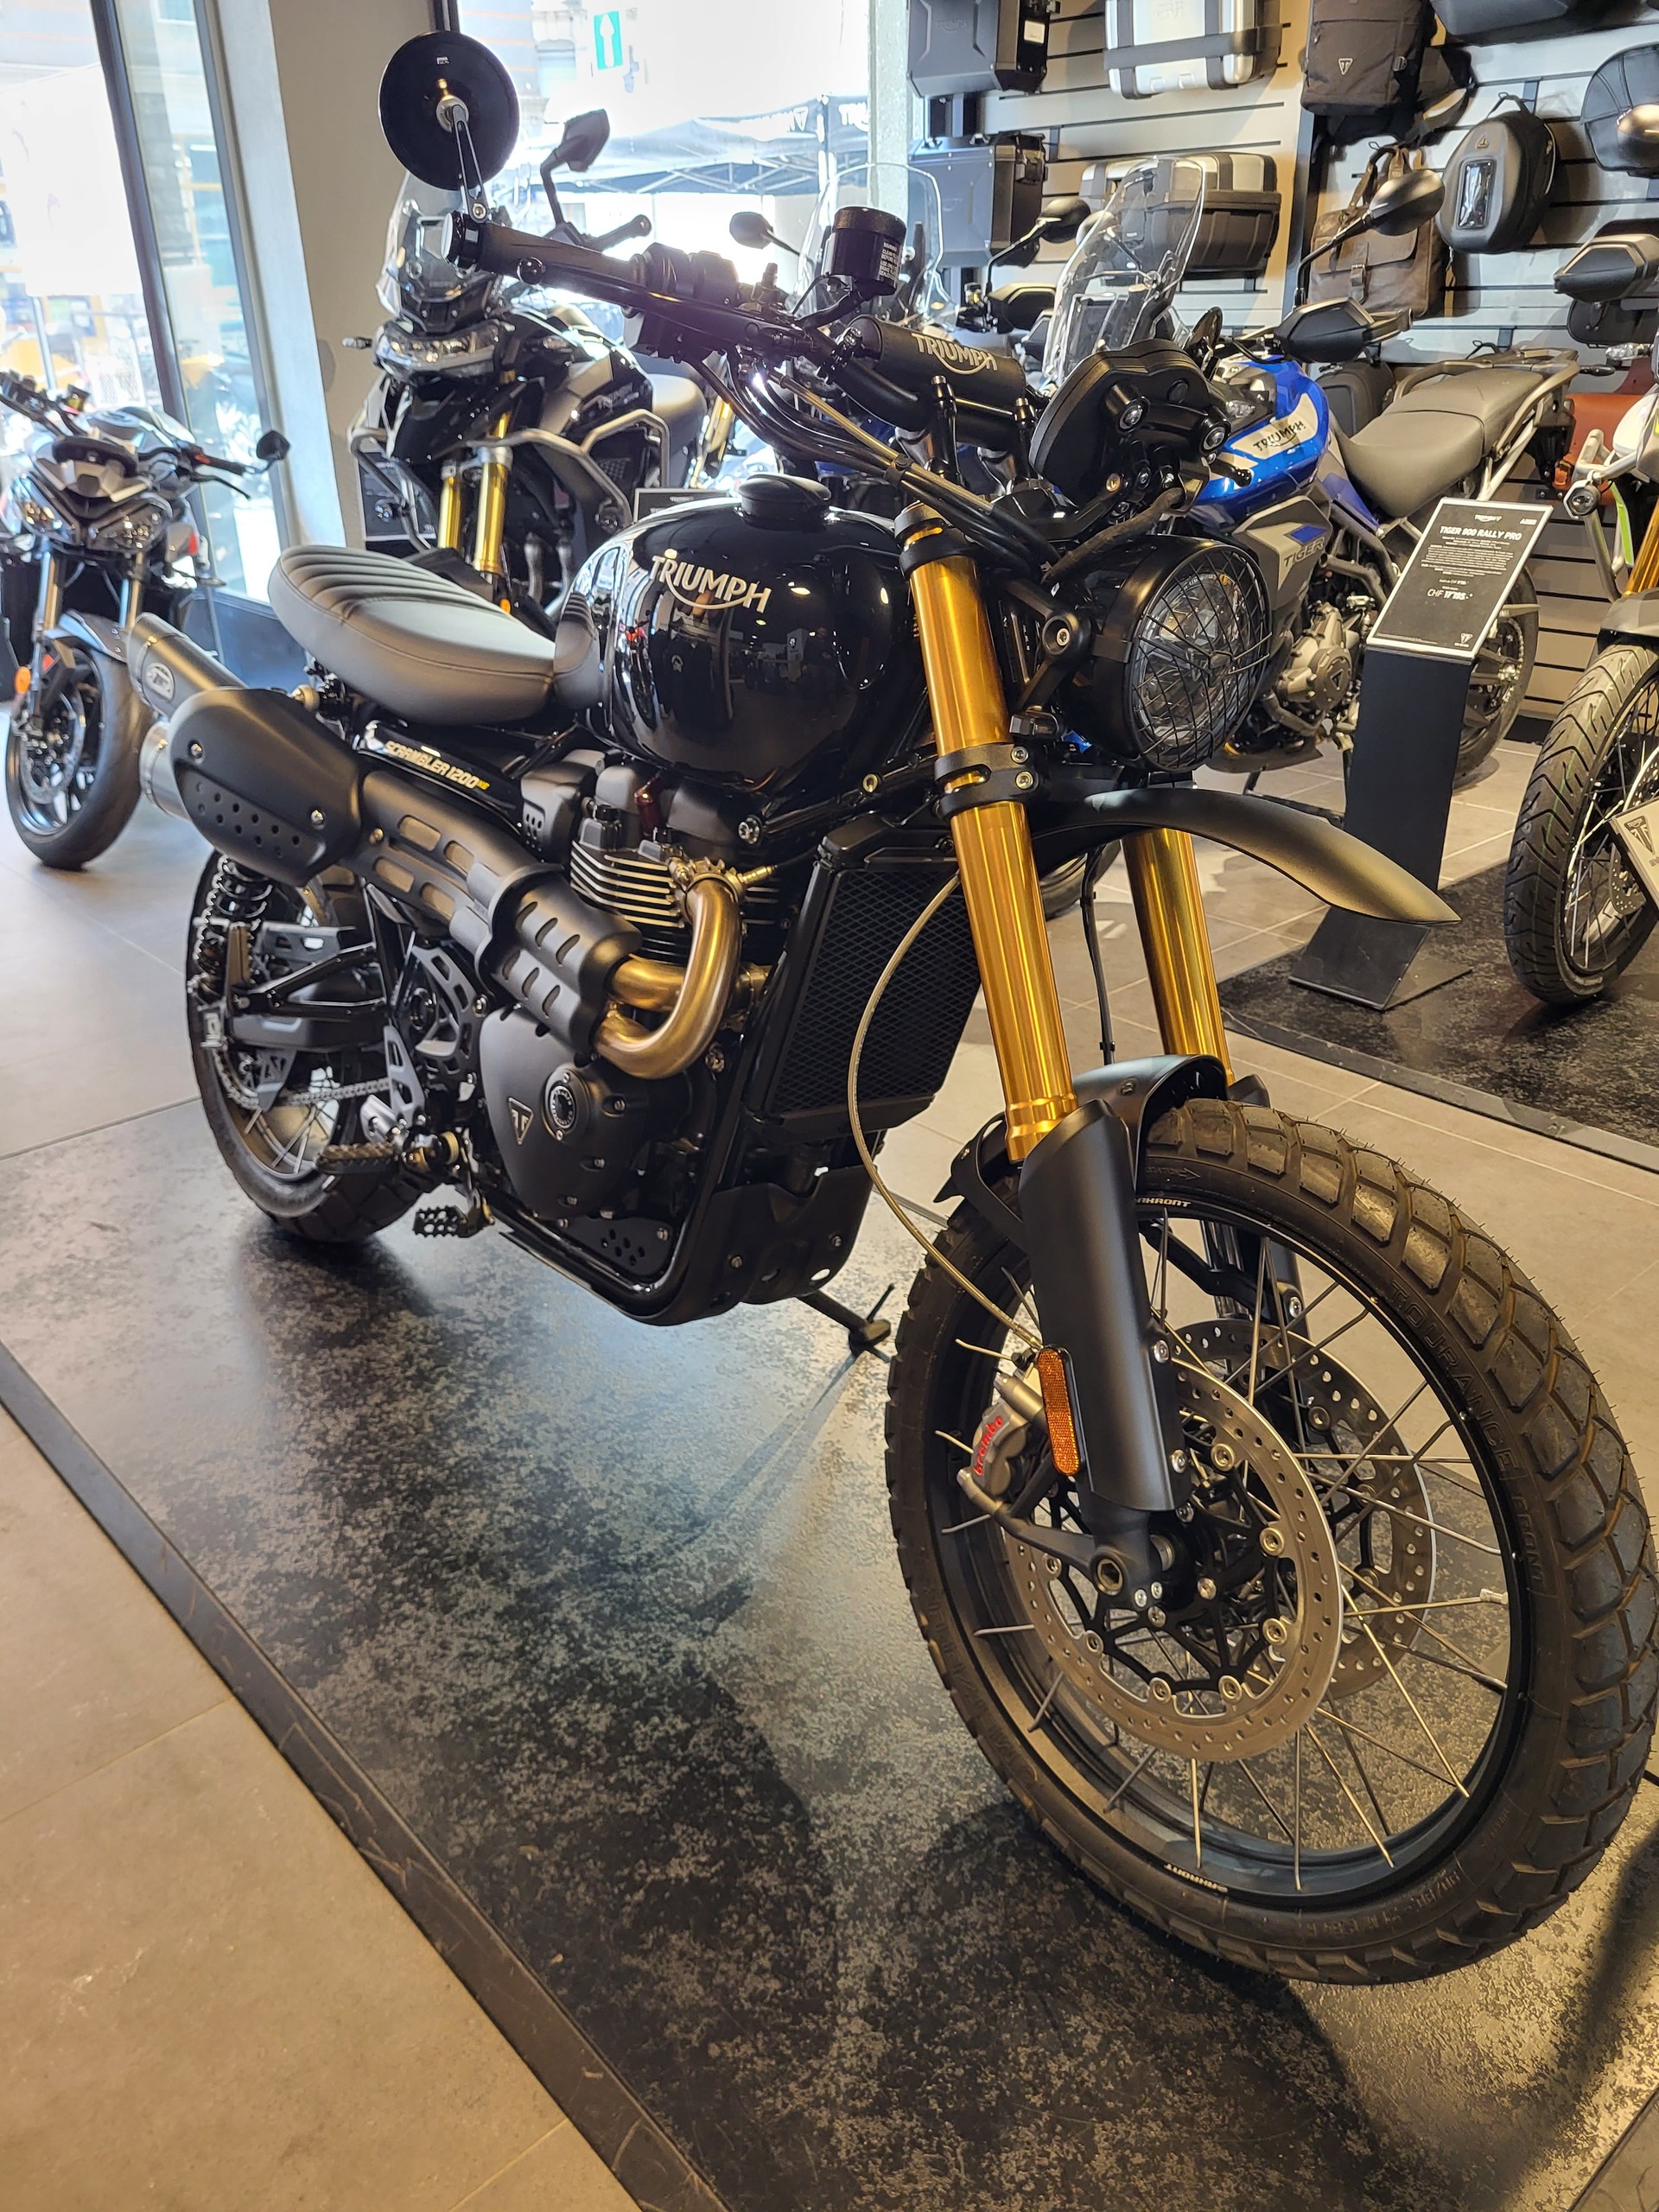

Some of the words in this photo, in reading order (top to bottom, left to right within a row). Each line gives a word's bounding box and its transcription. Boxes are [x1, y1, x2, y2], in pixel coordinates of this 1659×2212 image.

[911, 332, 998, 375] TRIUMPH
[1252, 420, 1306, 452] TRIUMPH
[1283, 536, 1325, 568] TIGER
[1440, 525, 1462, 536] TIGER
[1477, 530, 1504, 539] RALLY
[1503, 532, 1522, 541] PRO
[649, 555, 772, 613] TRIUMPH
[1427, 588, 1444, 598] CHF
[385, 740, 451, 777] SCRAMBLER
[445, 766, 480, 789] 1200
[1391, 1278, 1520, 1471] TOURANCE
[972, 1414, 1004, 1477] brembo
